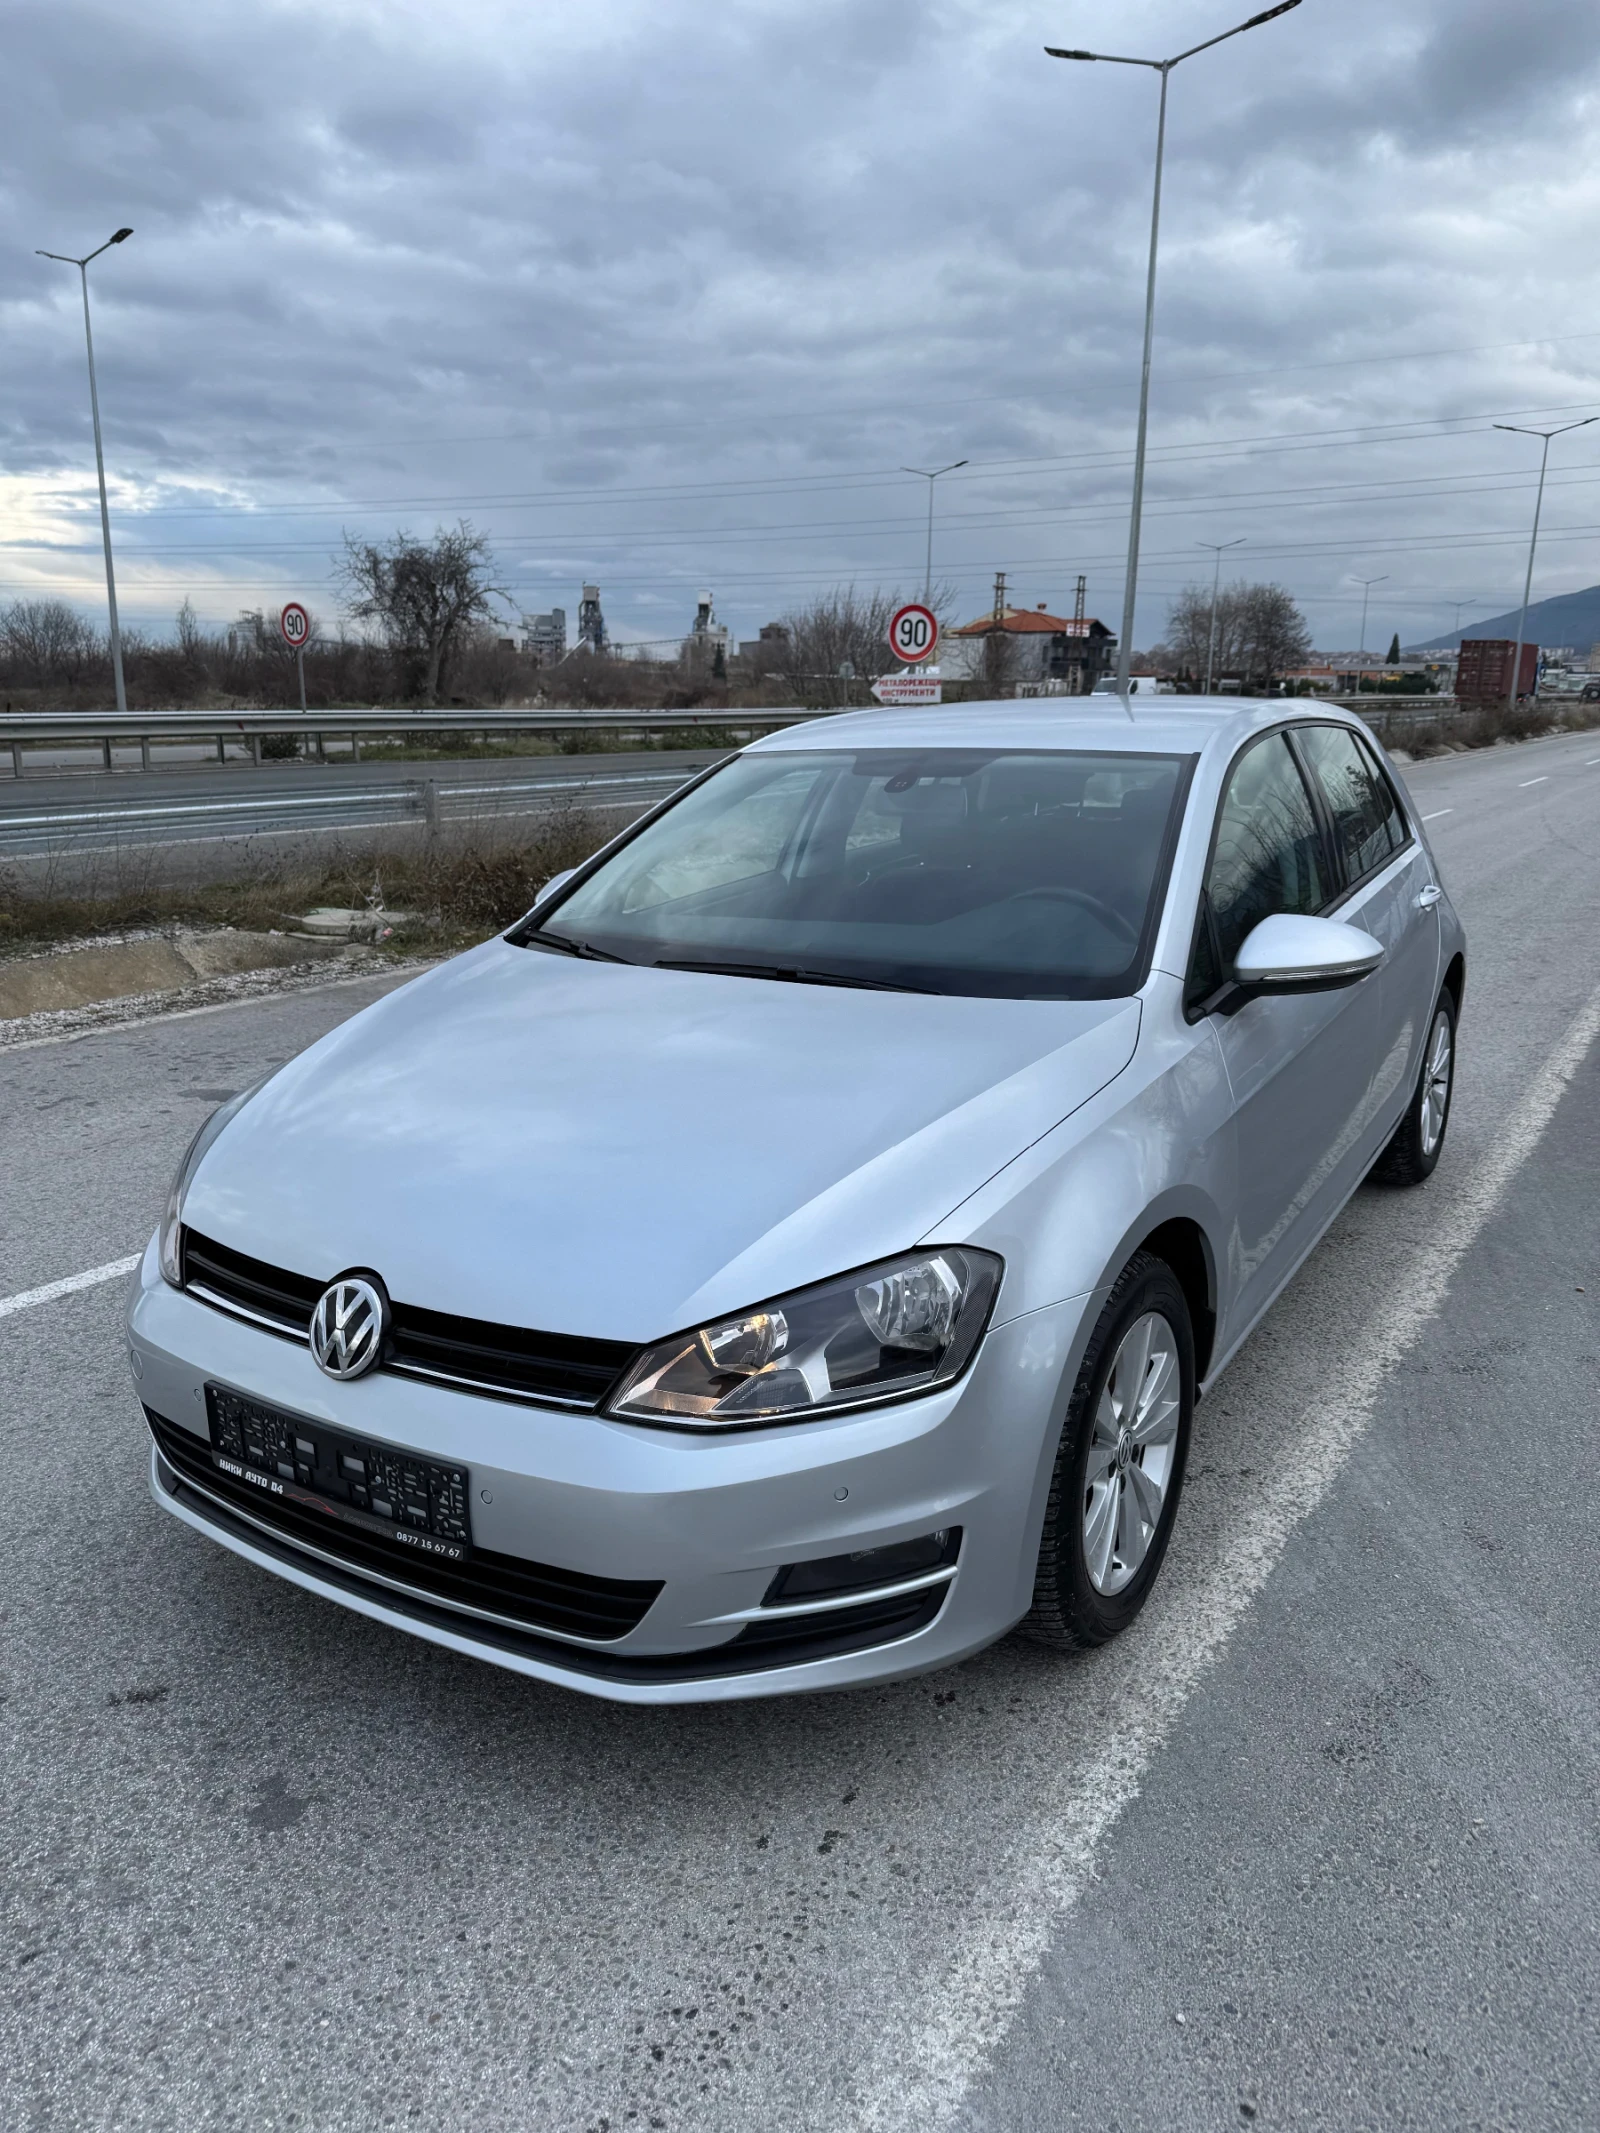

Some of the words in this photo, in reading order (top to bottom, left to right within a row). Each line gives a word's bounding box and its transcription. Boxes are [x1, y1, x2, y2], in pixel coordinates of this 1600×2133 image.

[287, 614, 303, 636] 90
[901, 619, 926, 647] 90
[219, 1458, 243, 1477] НИКИ
[396, 1531, 418, 1545] 0877
[421, 1538, 432, 1550] 15
[434, 1543, 446, 1554] 67
[448, 1547, 460, 1558] 67
